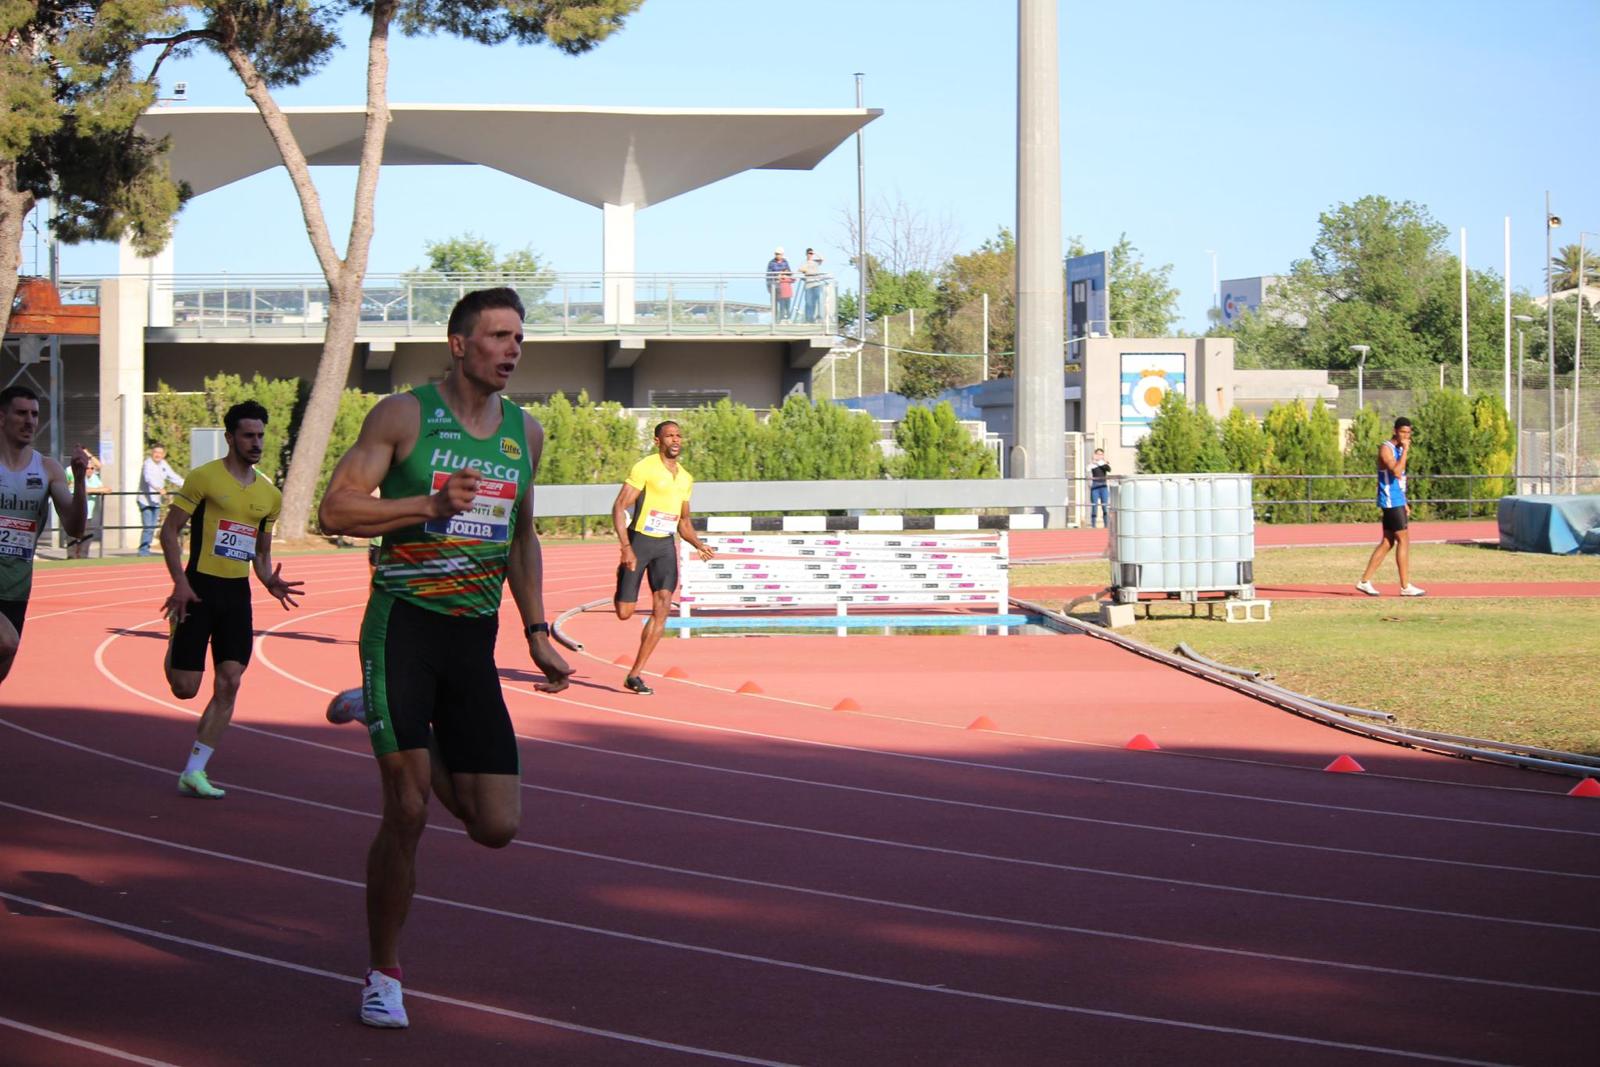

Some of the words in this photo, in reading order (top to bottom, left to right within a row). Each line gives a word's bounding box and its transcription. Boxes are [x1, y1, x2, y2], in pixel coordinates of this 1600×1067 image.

[430, 448, 520, 482] Huesca
[0, 530, 10, 543] 2
[221, 532, 237, 546] 20
